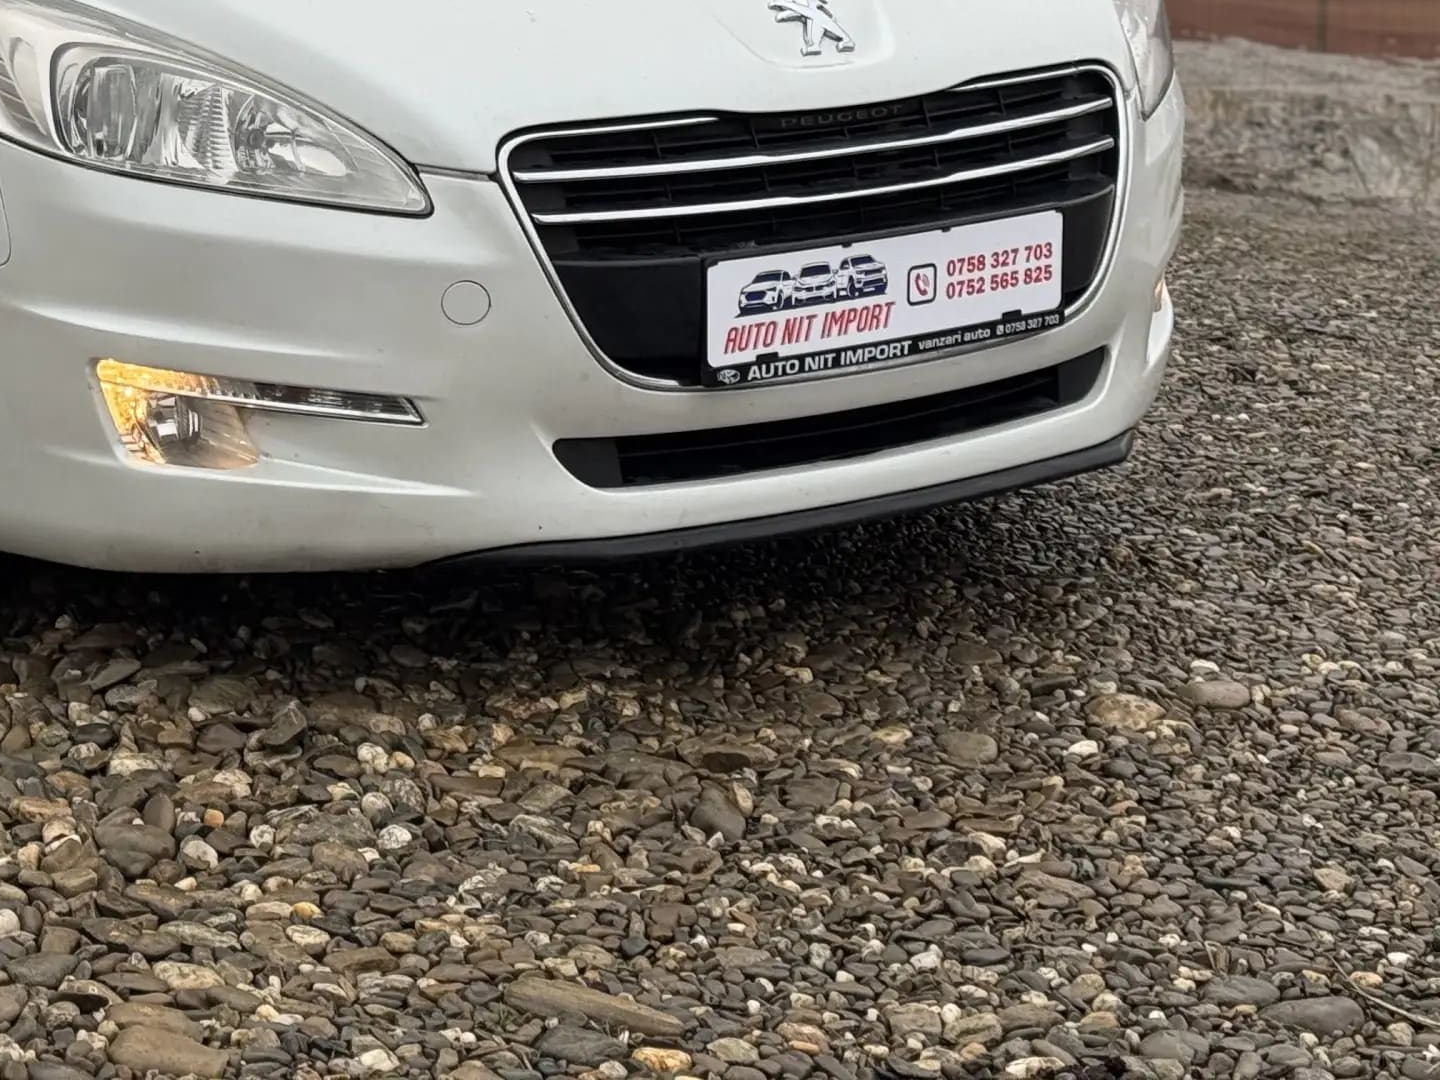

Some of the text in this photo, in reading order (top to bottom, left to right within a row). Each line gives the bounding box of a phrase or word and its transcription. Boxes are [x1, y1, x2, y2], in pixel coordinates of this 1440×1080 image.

[780, 103, 904, 128] PEUGEOT
[946, 242, 1053, 277] 0758 327 703
[946, 264, 1053, 300] 0752 565 825
[723, 301, 896, 355] AUTO NIT IMPORT
[747, 359, 800, 381] AUTO
[804, 352, 836, 370] NIT
[840, 341, 912, 366] IMPORT
[963, 327, 991, 342] auto
